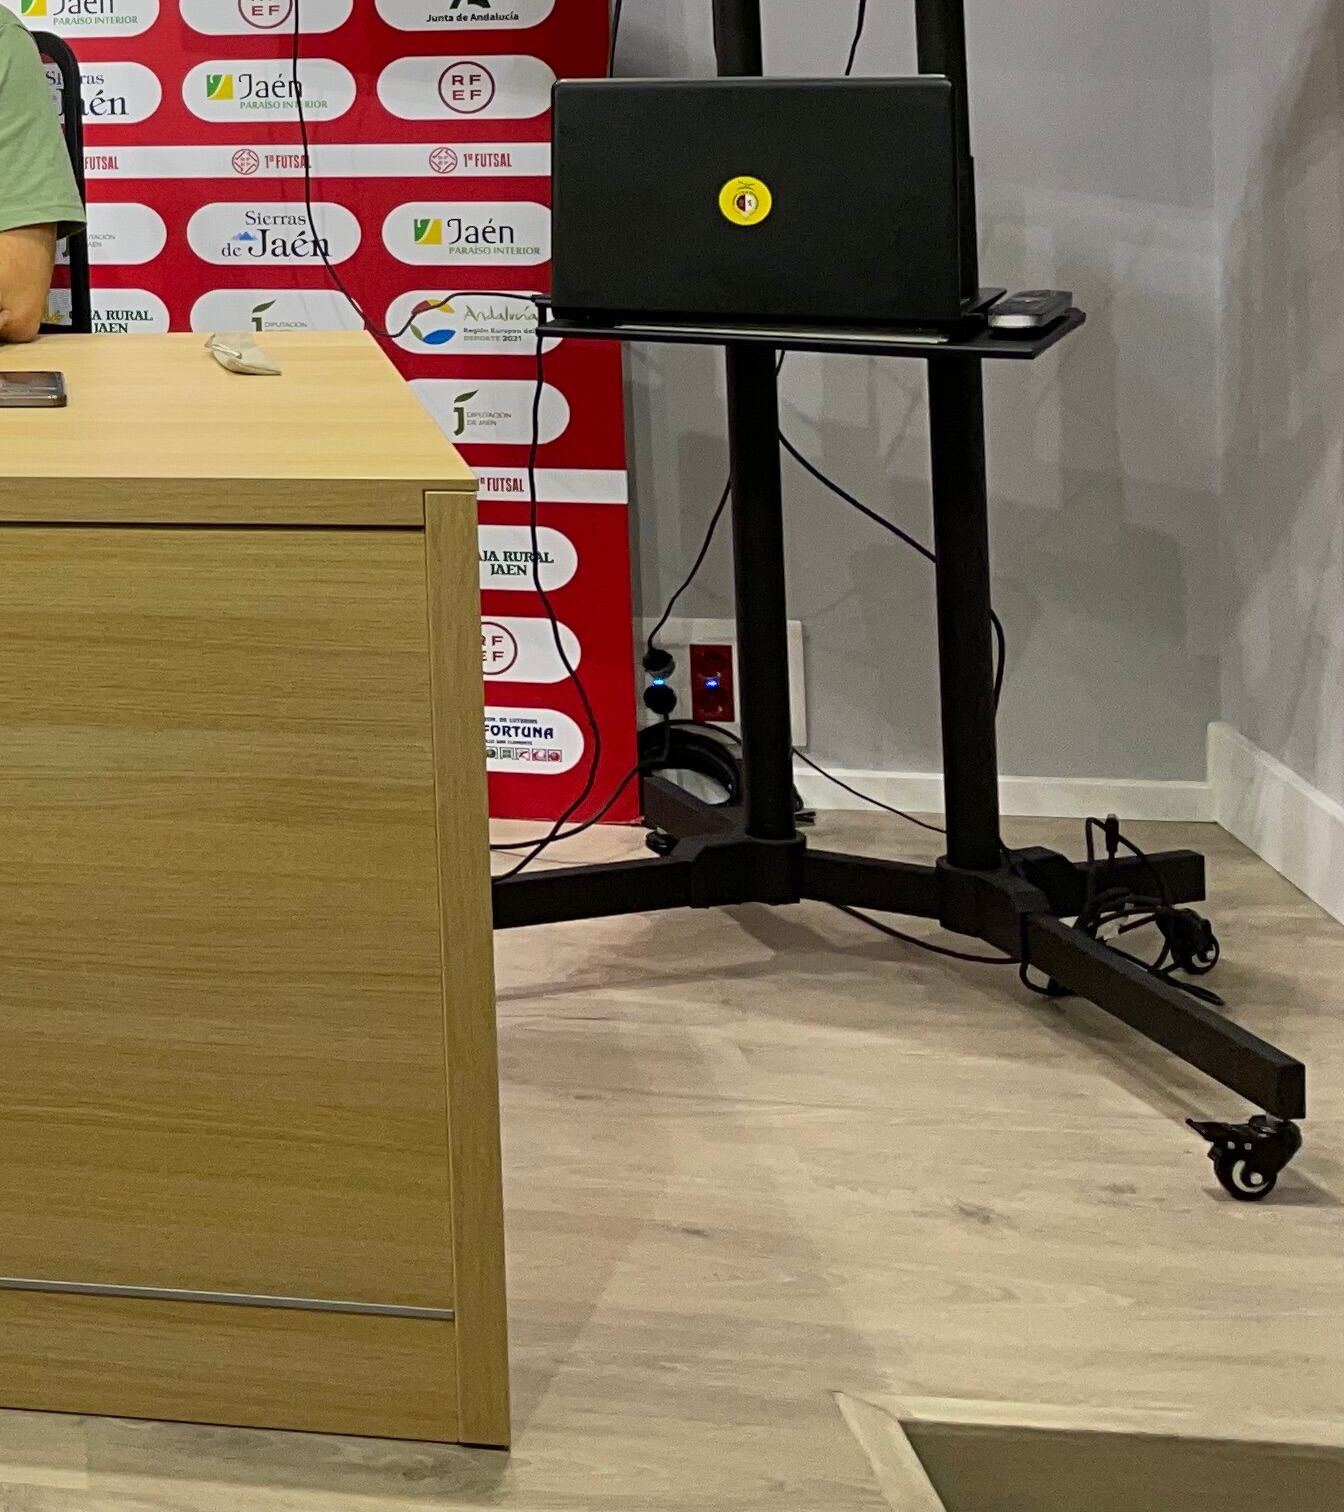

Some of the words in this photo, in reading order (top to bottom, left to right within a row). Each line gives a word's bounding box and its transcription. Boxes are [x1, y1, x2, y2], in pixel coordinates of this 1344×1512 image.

[95, 15, 138, 25] INTERIOR
[426, 13, 454, 23] Junta
[456, 13, 468, 22] de
[470, 11, 519, 22] Andalucía
[238, 74, 302, 99] Jaén
[475, 153, 512, 167] FUTSAL
[245, 211, 306, 226] Sierras
[447, 218, 514, 244] Jaén
[221, 242, 243, 257] de
[247, 228, 330, 258] Jaén
[493, 246, 540, 255] INTERIOR
[106, 310, 153, 321] RURAL
[93, 322, 128, 333] JAEN
[487, 477, 524, 492] FUTSAL
[490, 564, 528, 576] JAEN
